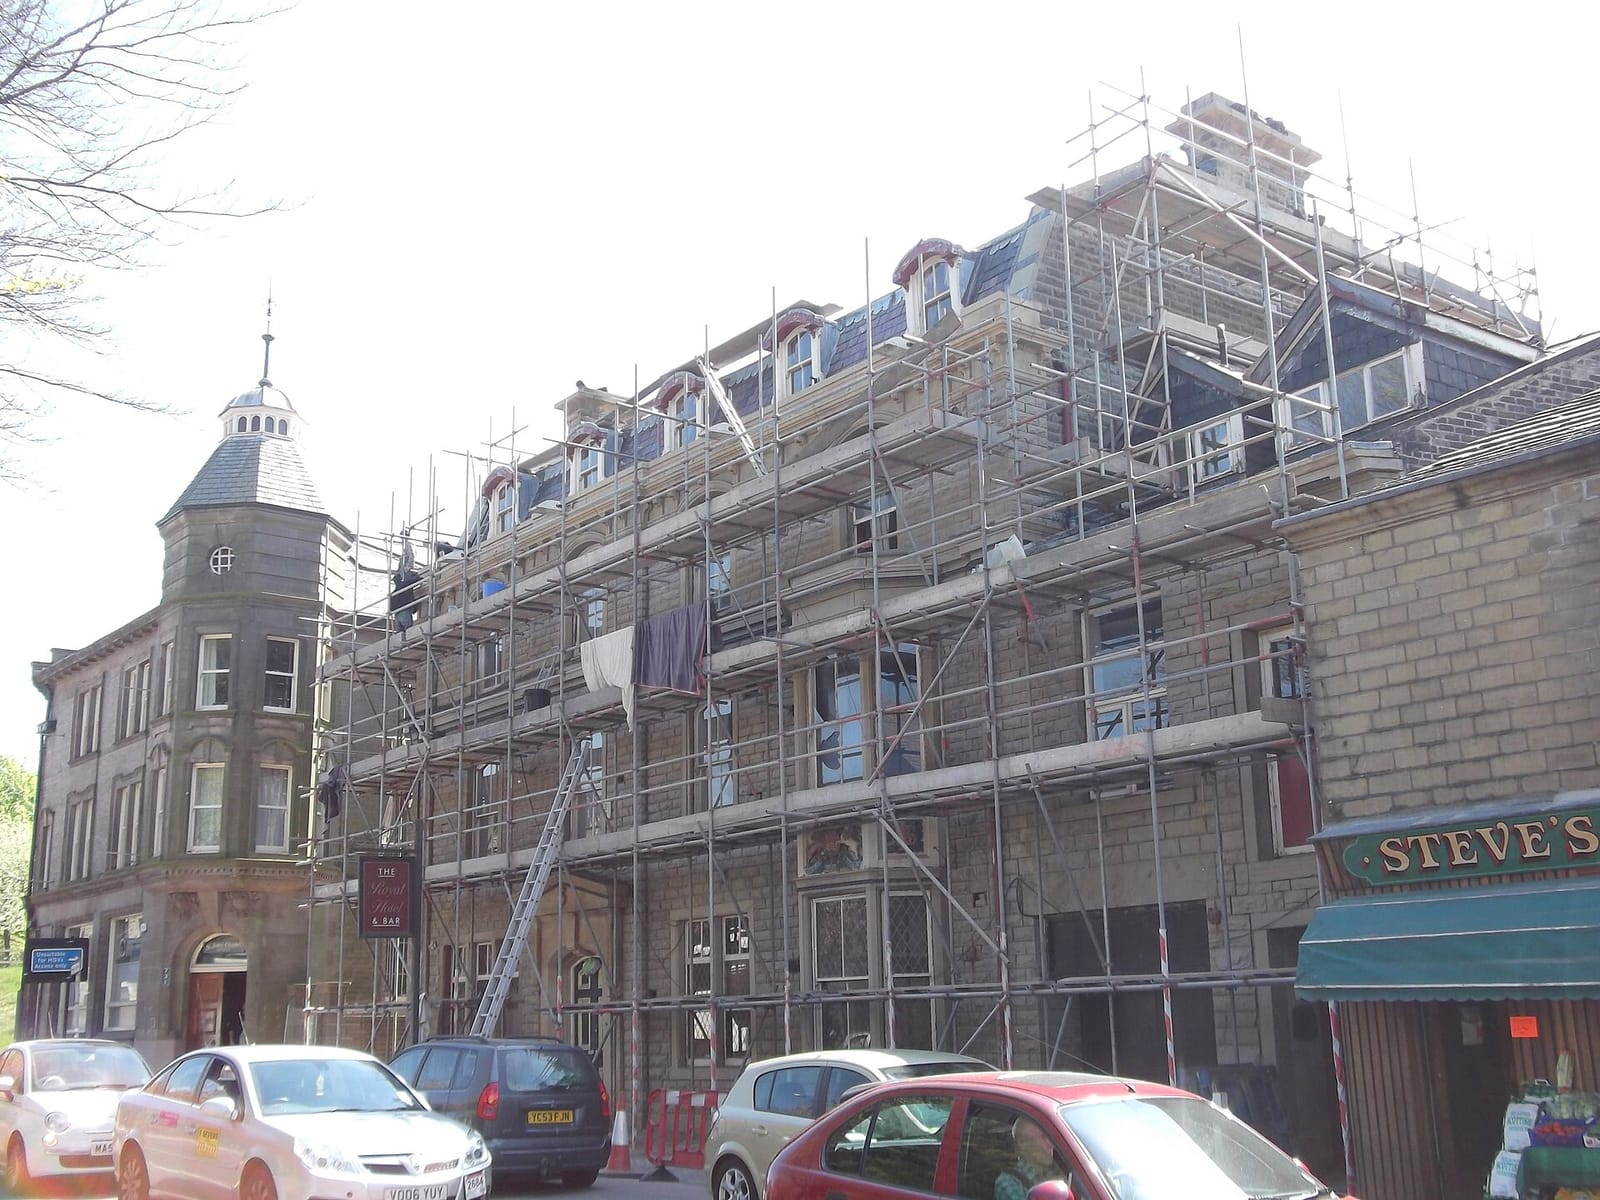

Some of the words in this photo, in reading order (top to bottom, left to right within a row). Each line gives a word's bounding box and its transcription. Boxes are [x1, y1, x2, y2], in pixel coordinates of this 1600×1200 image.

[1378, 815, 1600, 874] STEVE'S
[378, 867, 396, 876] THE
[369, 882, 406, 898] Royal
[369, 901, 404, 914] Hotel
[371, 916, 378, 925] &
[382, 916, 401, 925] BAR
